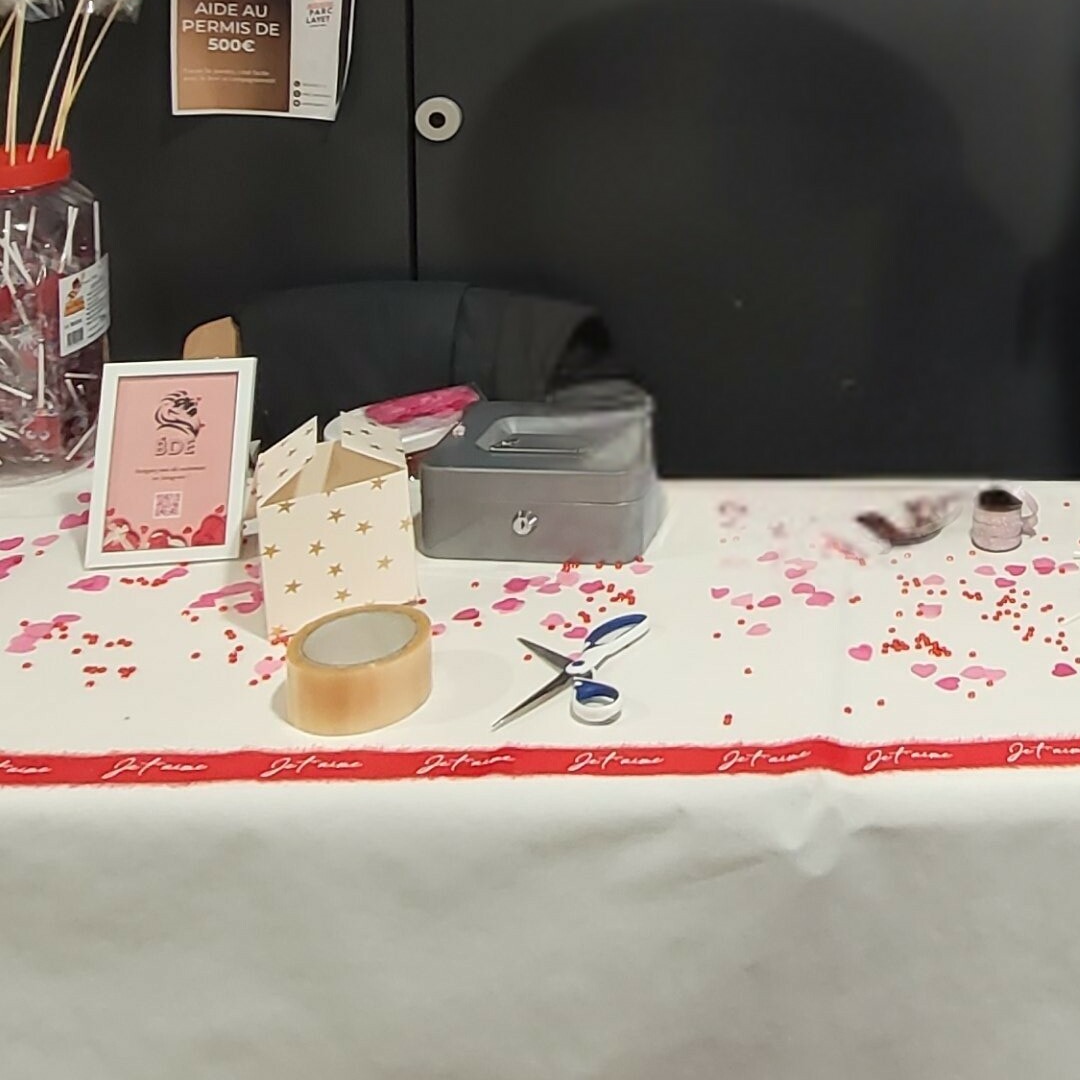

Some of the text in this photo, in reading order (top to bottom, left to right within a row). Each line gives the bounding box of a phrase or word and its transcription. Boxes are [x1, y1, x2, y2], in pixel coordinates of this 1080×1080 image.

[194, 2, 268, 18] AIDE AU
[182, 19, 280, 37] PERMIS DE
[208, 38, 255, 52] 500€
[155, 438, 196, 457] BDE
